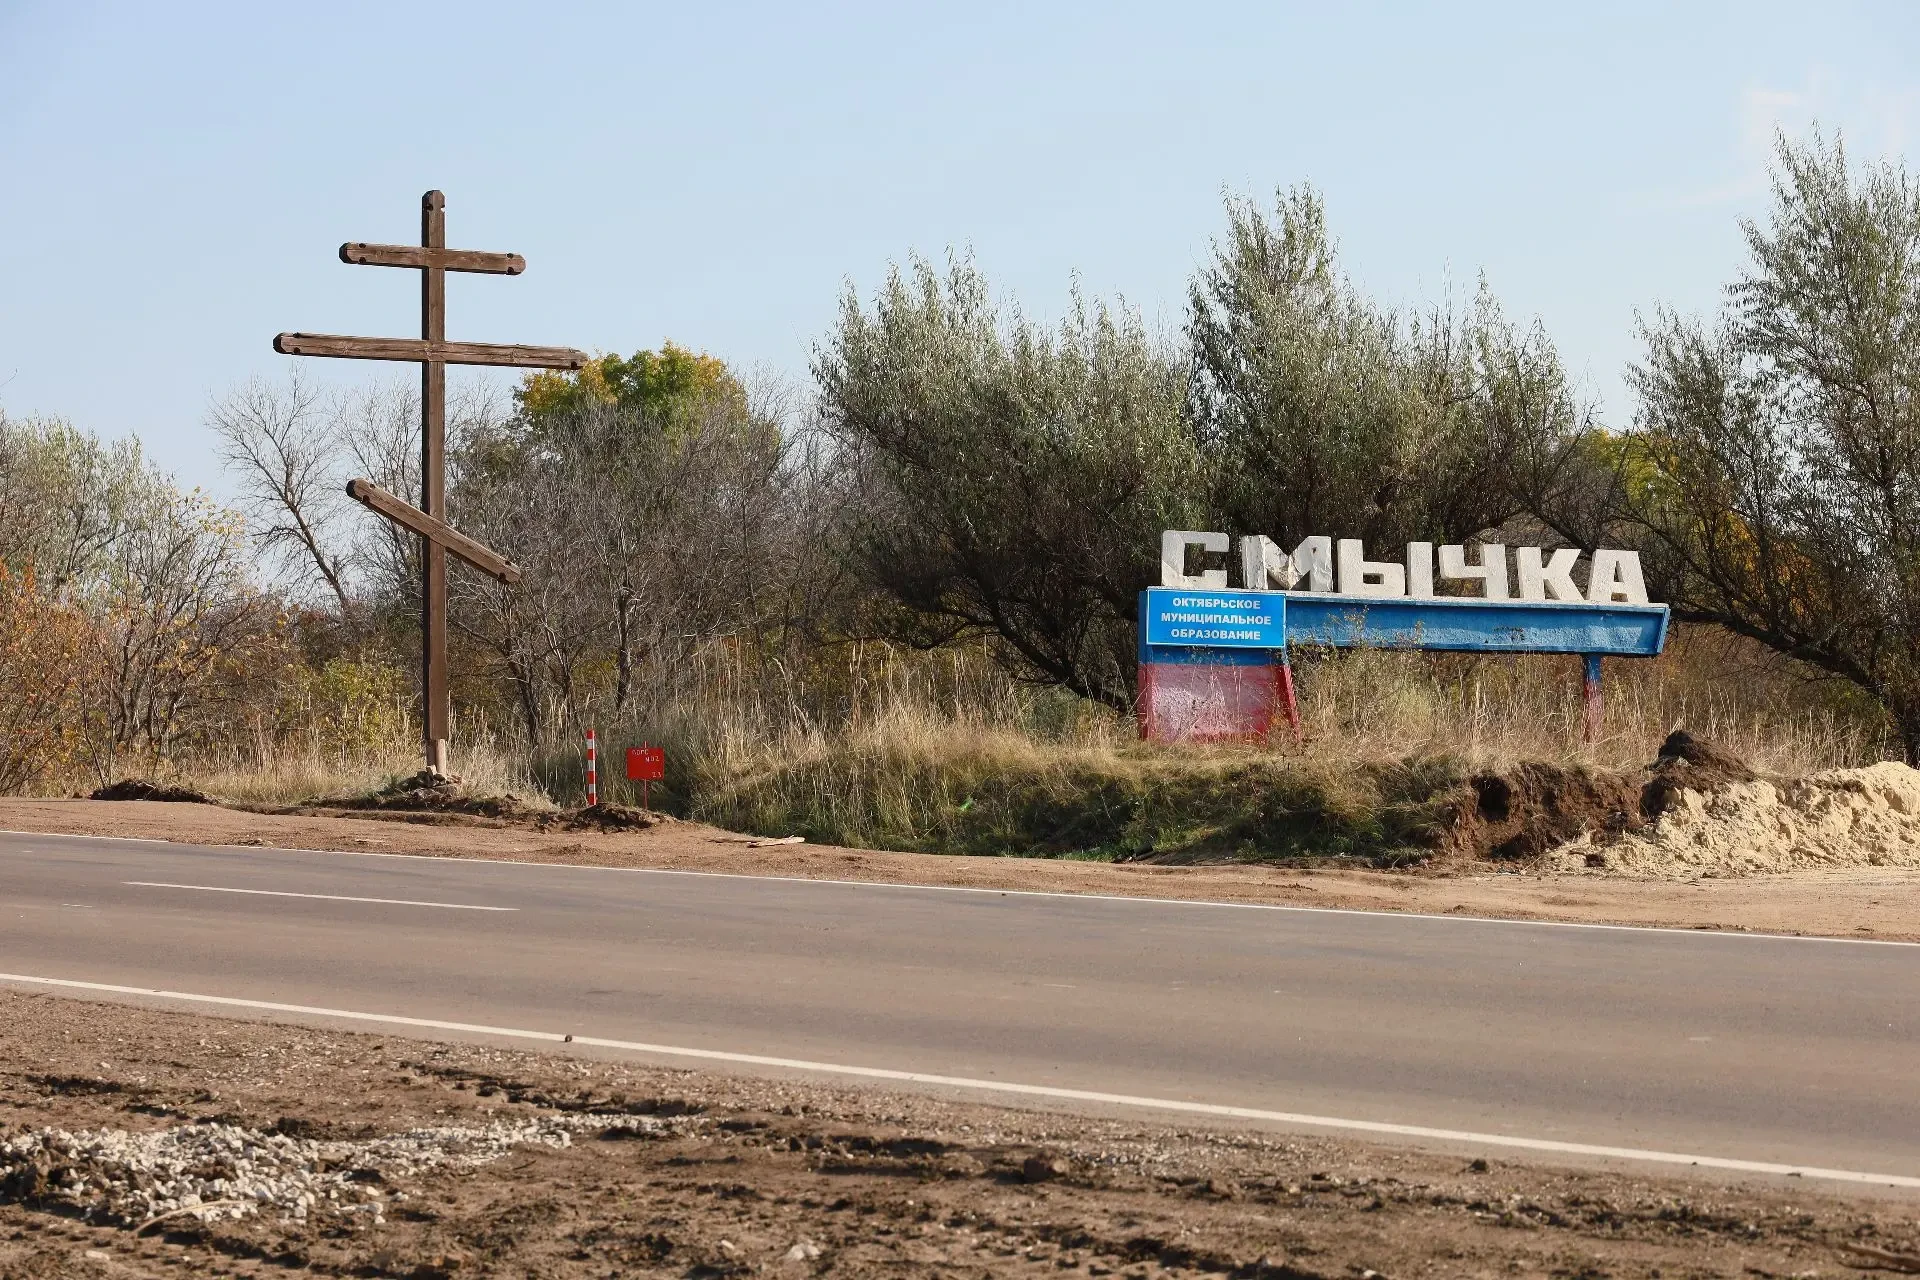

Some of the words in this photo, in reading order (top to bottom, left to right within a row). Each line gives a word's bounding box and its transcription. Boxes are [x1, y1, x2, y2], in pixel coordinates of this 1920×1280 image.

[1160, 530, 1648, 602] СМЫЧКА
[1172, 597, 1261, 610] ОКТЯБРЬСКОЕ
[1161, 612, 1272, 625] МУНИЦИПАЛЬНОЕ
[1171, 628, 1261, 640] ОБРАЗОВАНИЕ
